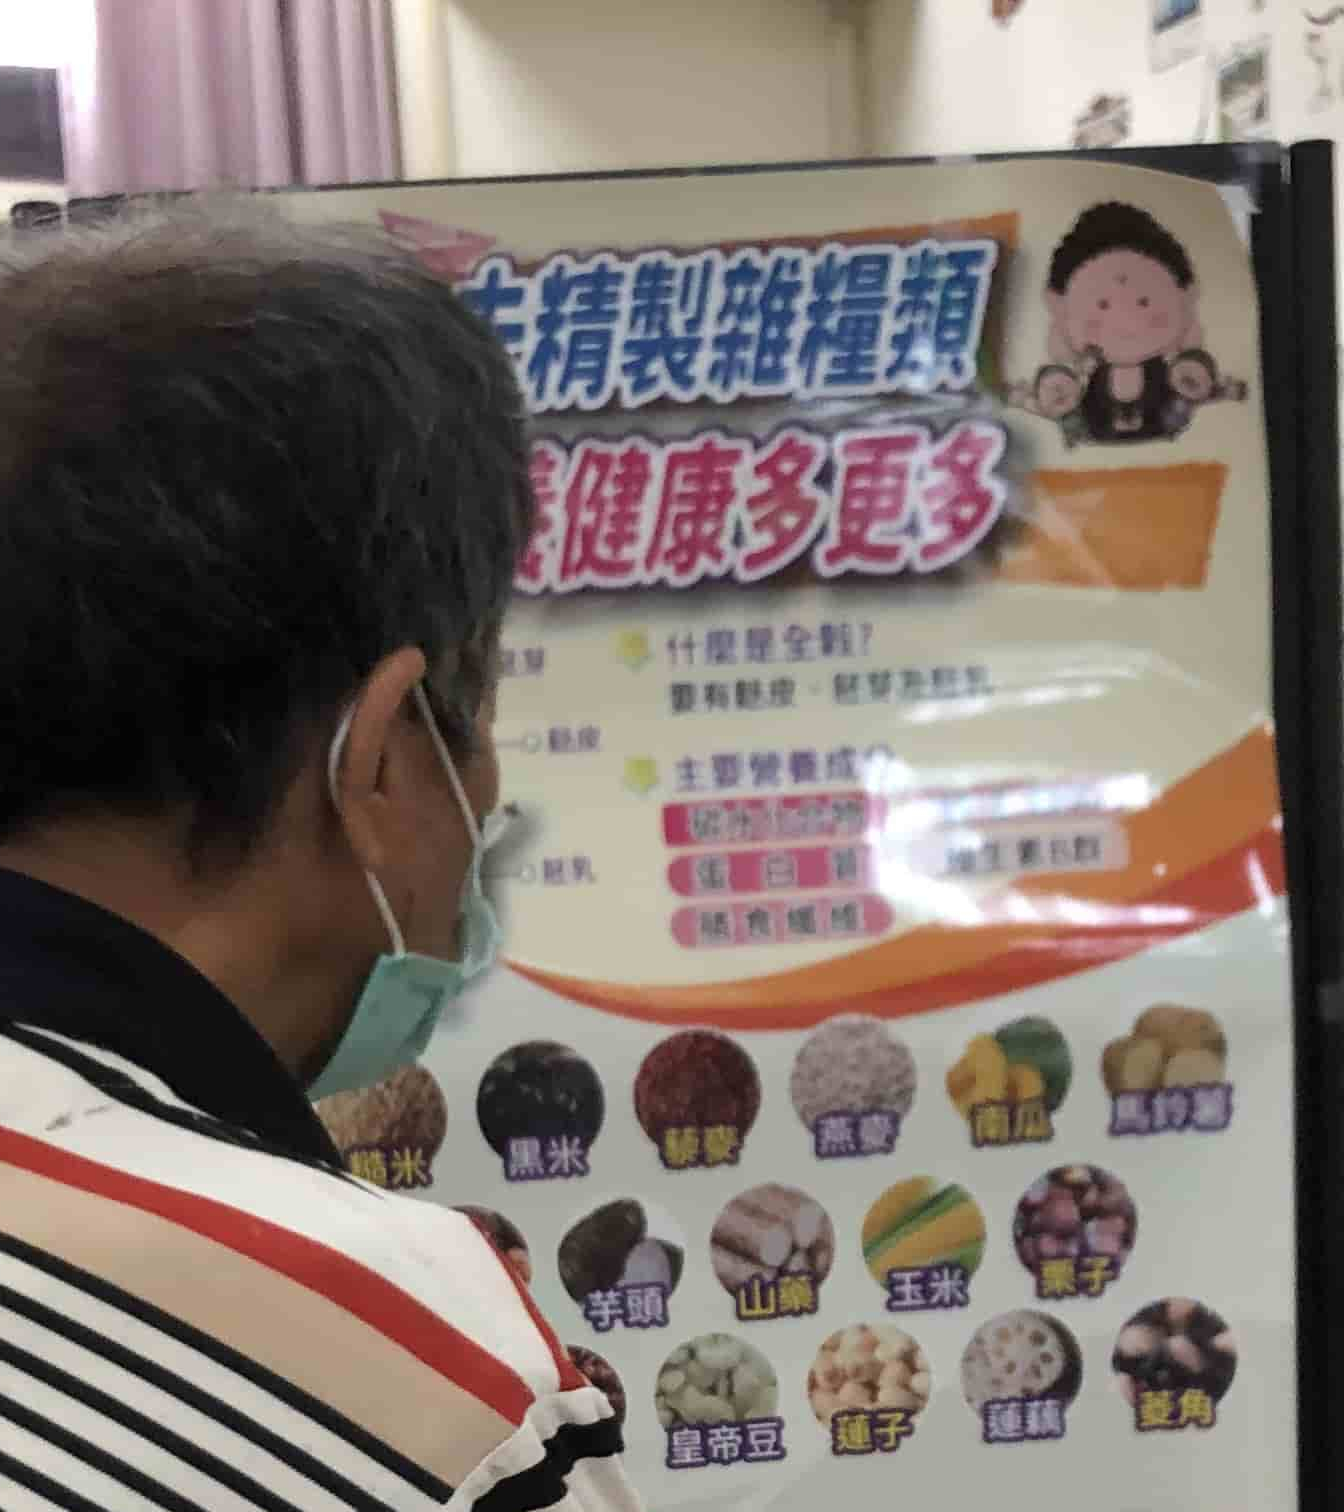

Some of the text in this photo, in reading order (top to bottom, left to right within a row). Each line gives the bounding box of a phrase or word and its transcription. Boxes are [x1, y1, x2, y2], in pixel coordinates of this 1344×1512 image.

[508, 1135, 587, 1179] 黑米
[586, 1284, 668, 1329] 芋頭
[890, 1265, 968, 1309] 玉米
[835, 1410, 913, 1453] 蓮子
[1137, 1391, 1215, 1431] 菱角
[669, 1421, 785, 1467] 皇帝豆
